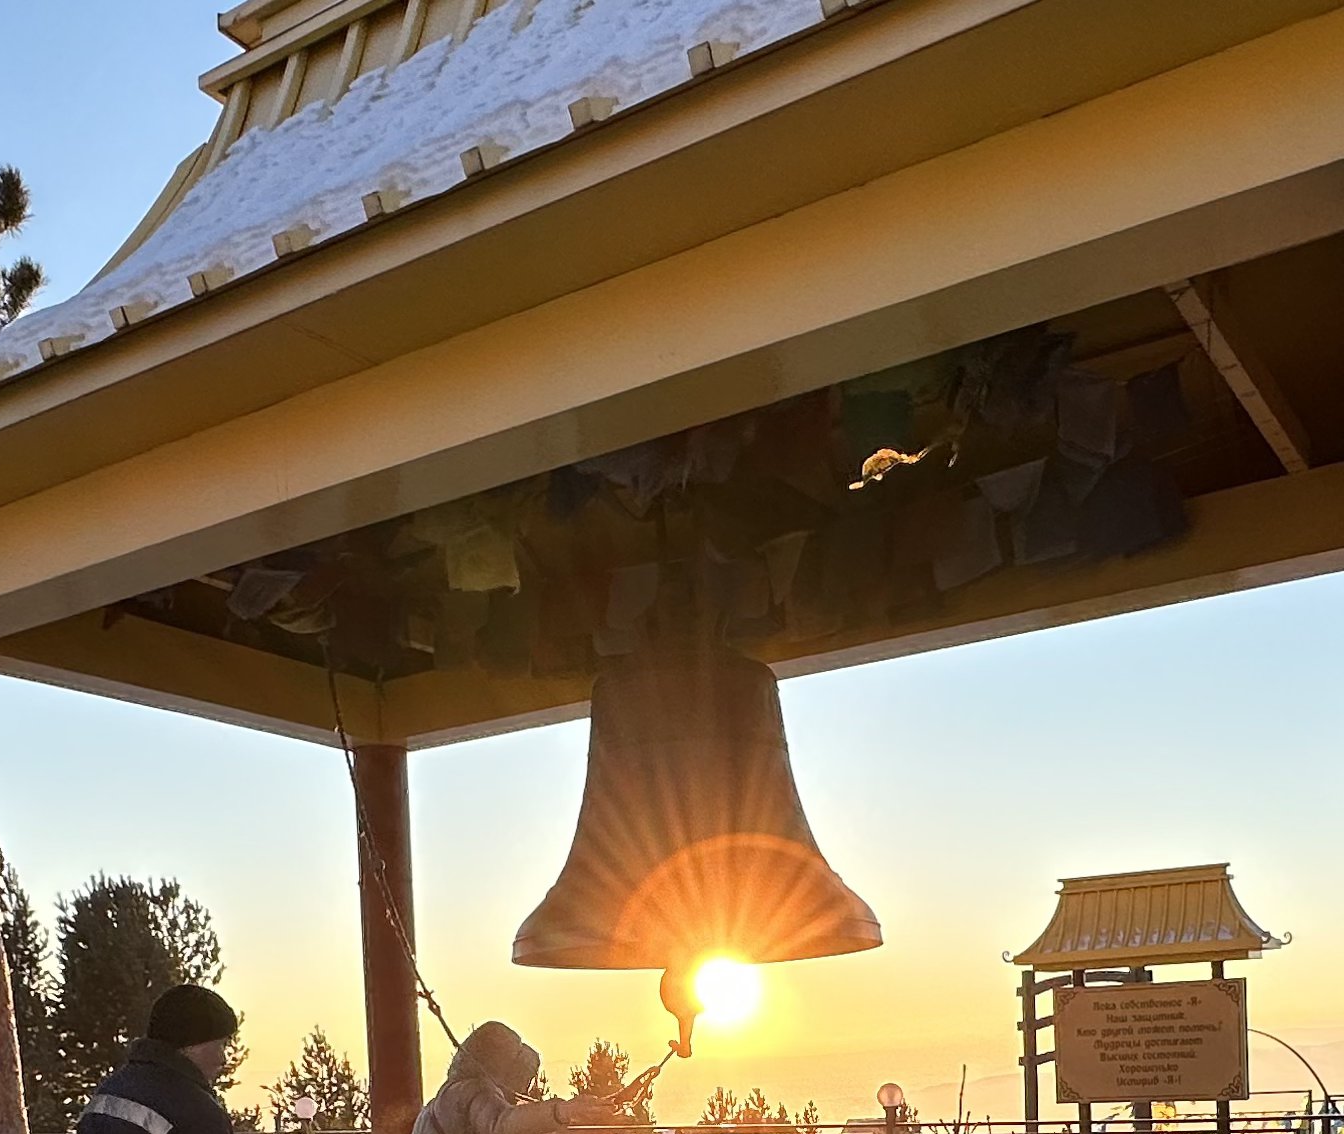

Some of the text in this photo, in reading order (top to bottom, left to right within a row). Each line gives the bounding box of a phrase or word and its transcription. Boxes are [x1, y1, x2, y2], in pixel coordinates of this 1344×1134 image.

[1106, 1014, 1127, 1023] Наш
[1076, 1028, 1097, 1037] Кто
[1101, 1025, 1133, 1038] другой
[1137, 1024, 1175, 1035] может
[1144, 1037, 1203, 1049] достигают
[1099, 1052, 1139, 1062] Высших
[1119, 1063, 1179, 1074] Хорошенько
